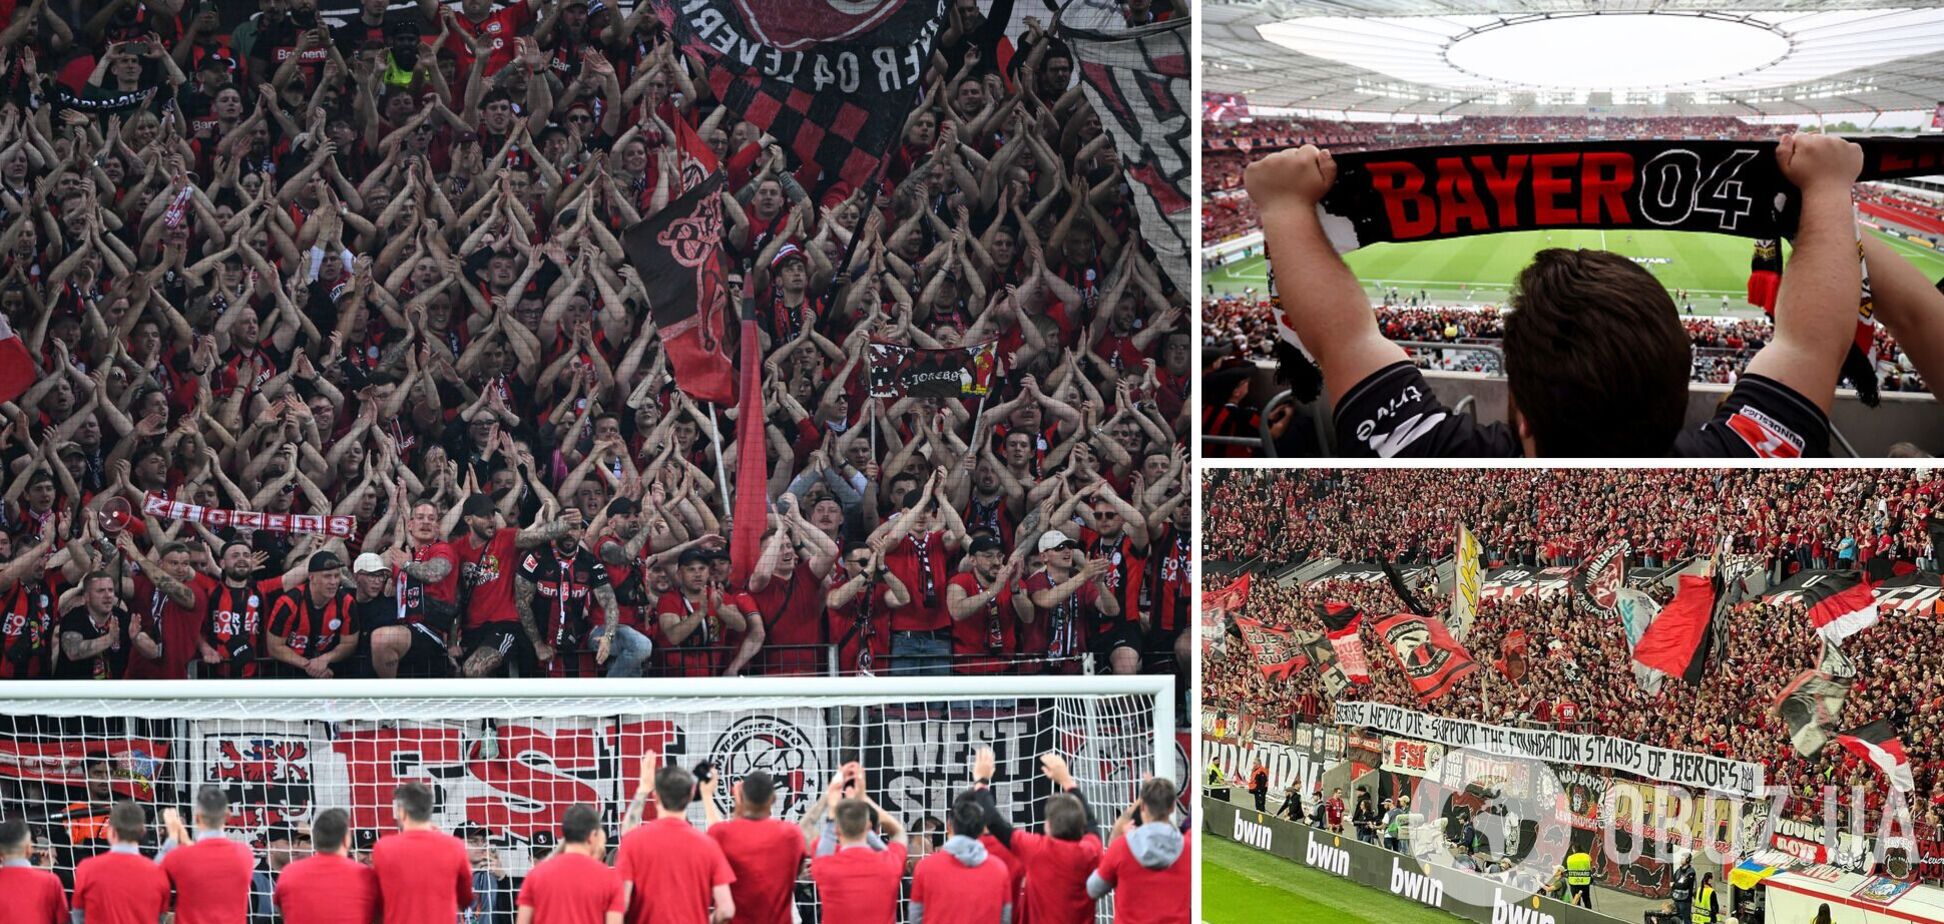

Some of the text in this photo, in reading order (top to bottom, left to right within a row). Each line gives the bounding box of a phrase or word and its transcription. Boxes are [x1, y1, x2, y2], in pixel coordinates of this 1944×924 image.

[1365, 149, 1760, 239] BAYER 04
[1743, 407, 1804, 449] BUNDESLIGA
[144, 496, 351, 537] KICKERS
[887, 719, 1027, 776] WEST
[1336, 703, 1738, 790] HEROES NEVER DIE SUPPORT THE FOUNDATION STANDS OF HEROES
[1394, 741, 1427, 772] FSI
[1445, 762, 1463, 777] SIDE
[887, 775, 1027, 833] SIE
[1233, 809, 1273, 850] bwin
[1775, 818, 1827, 844] YOUNG
[1305, 830, 1350, 877] bwin
[1390, 857, 1444, 908] bwin
